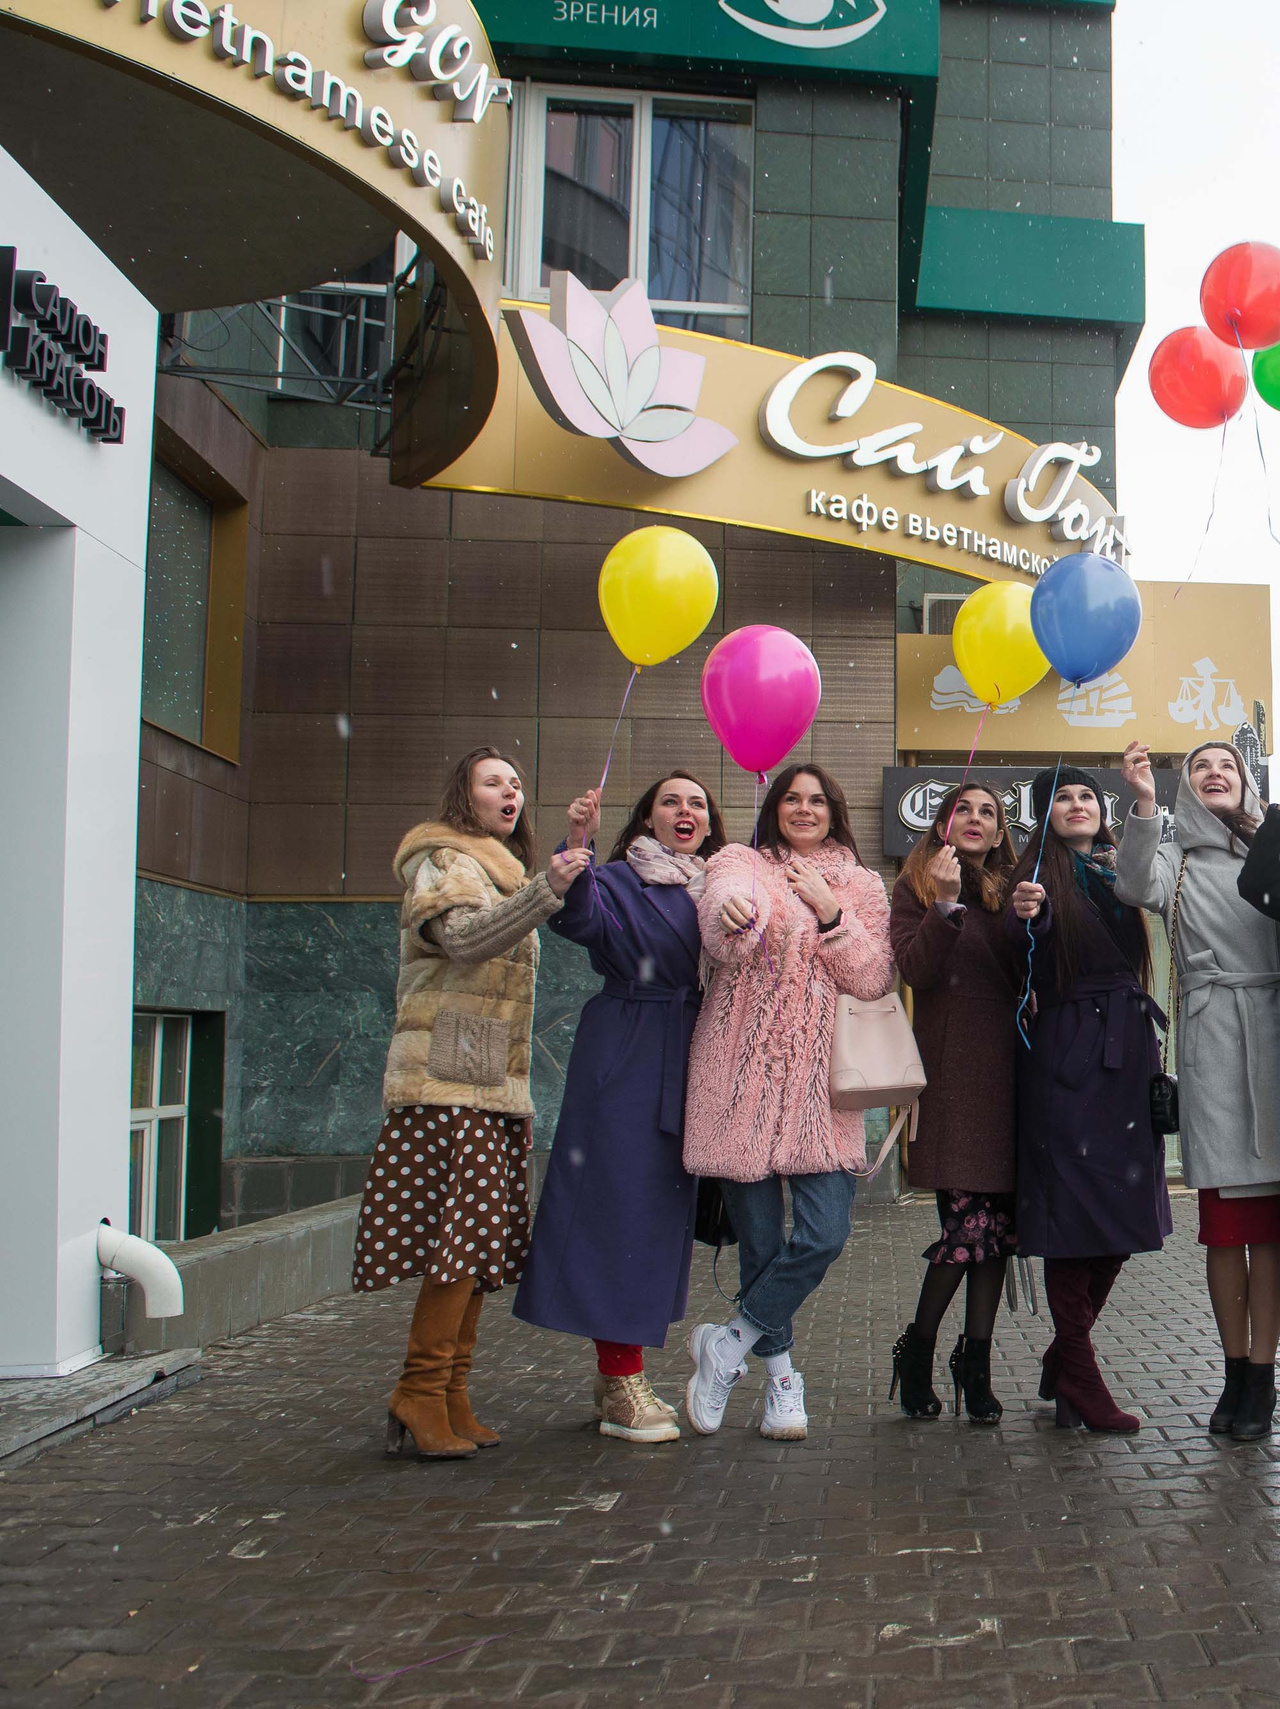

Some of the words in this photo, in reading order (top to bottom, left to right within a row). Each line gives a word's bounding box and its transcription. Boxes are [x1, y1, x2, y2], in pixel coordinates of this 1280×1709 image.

[552, 0, 658, 29] ЗРЕНИЯ
[444, 177, 495, 261] cafe
[18, 269, 109, 372] САЛОН
[10, 326, 126, 444] КРАСОТЫ
[760, 351, 1005, 498] Сай
[808, 488, 900, 532] кафе
[905, 512, 1060, 576] вьетнамско
